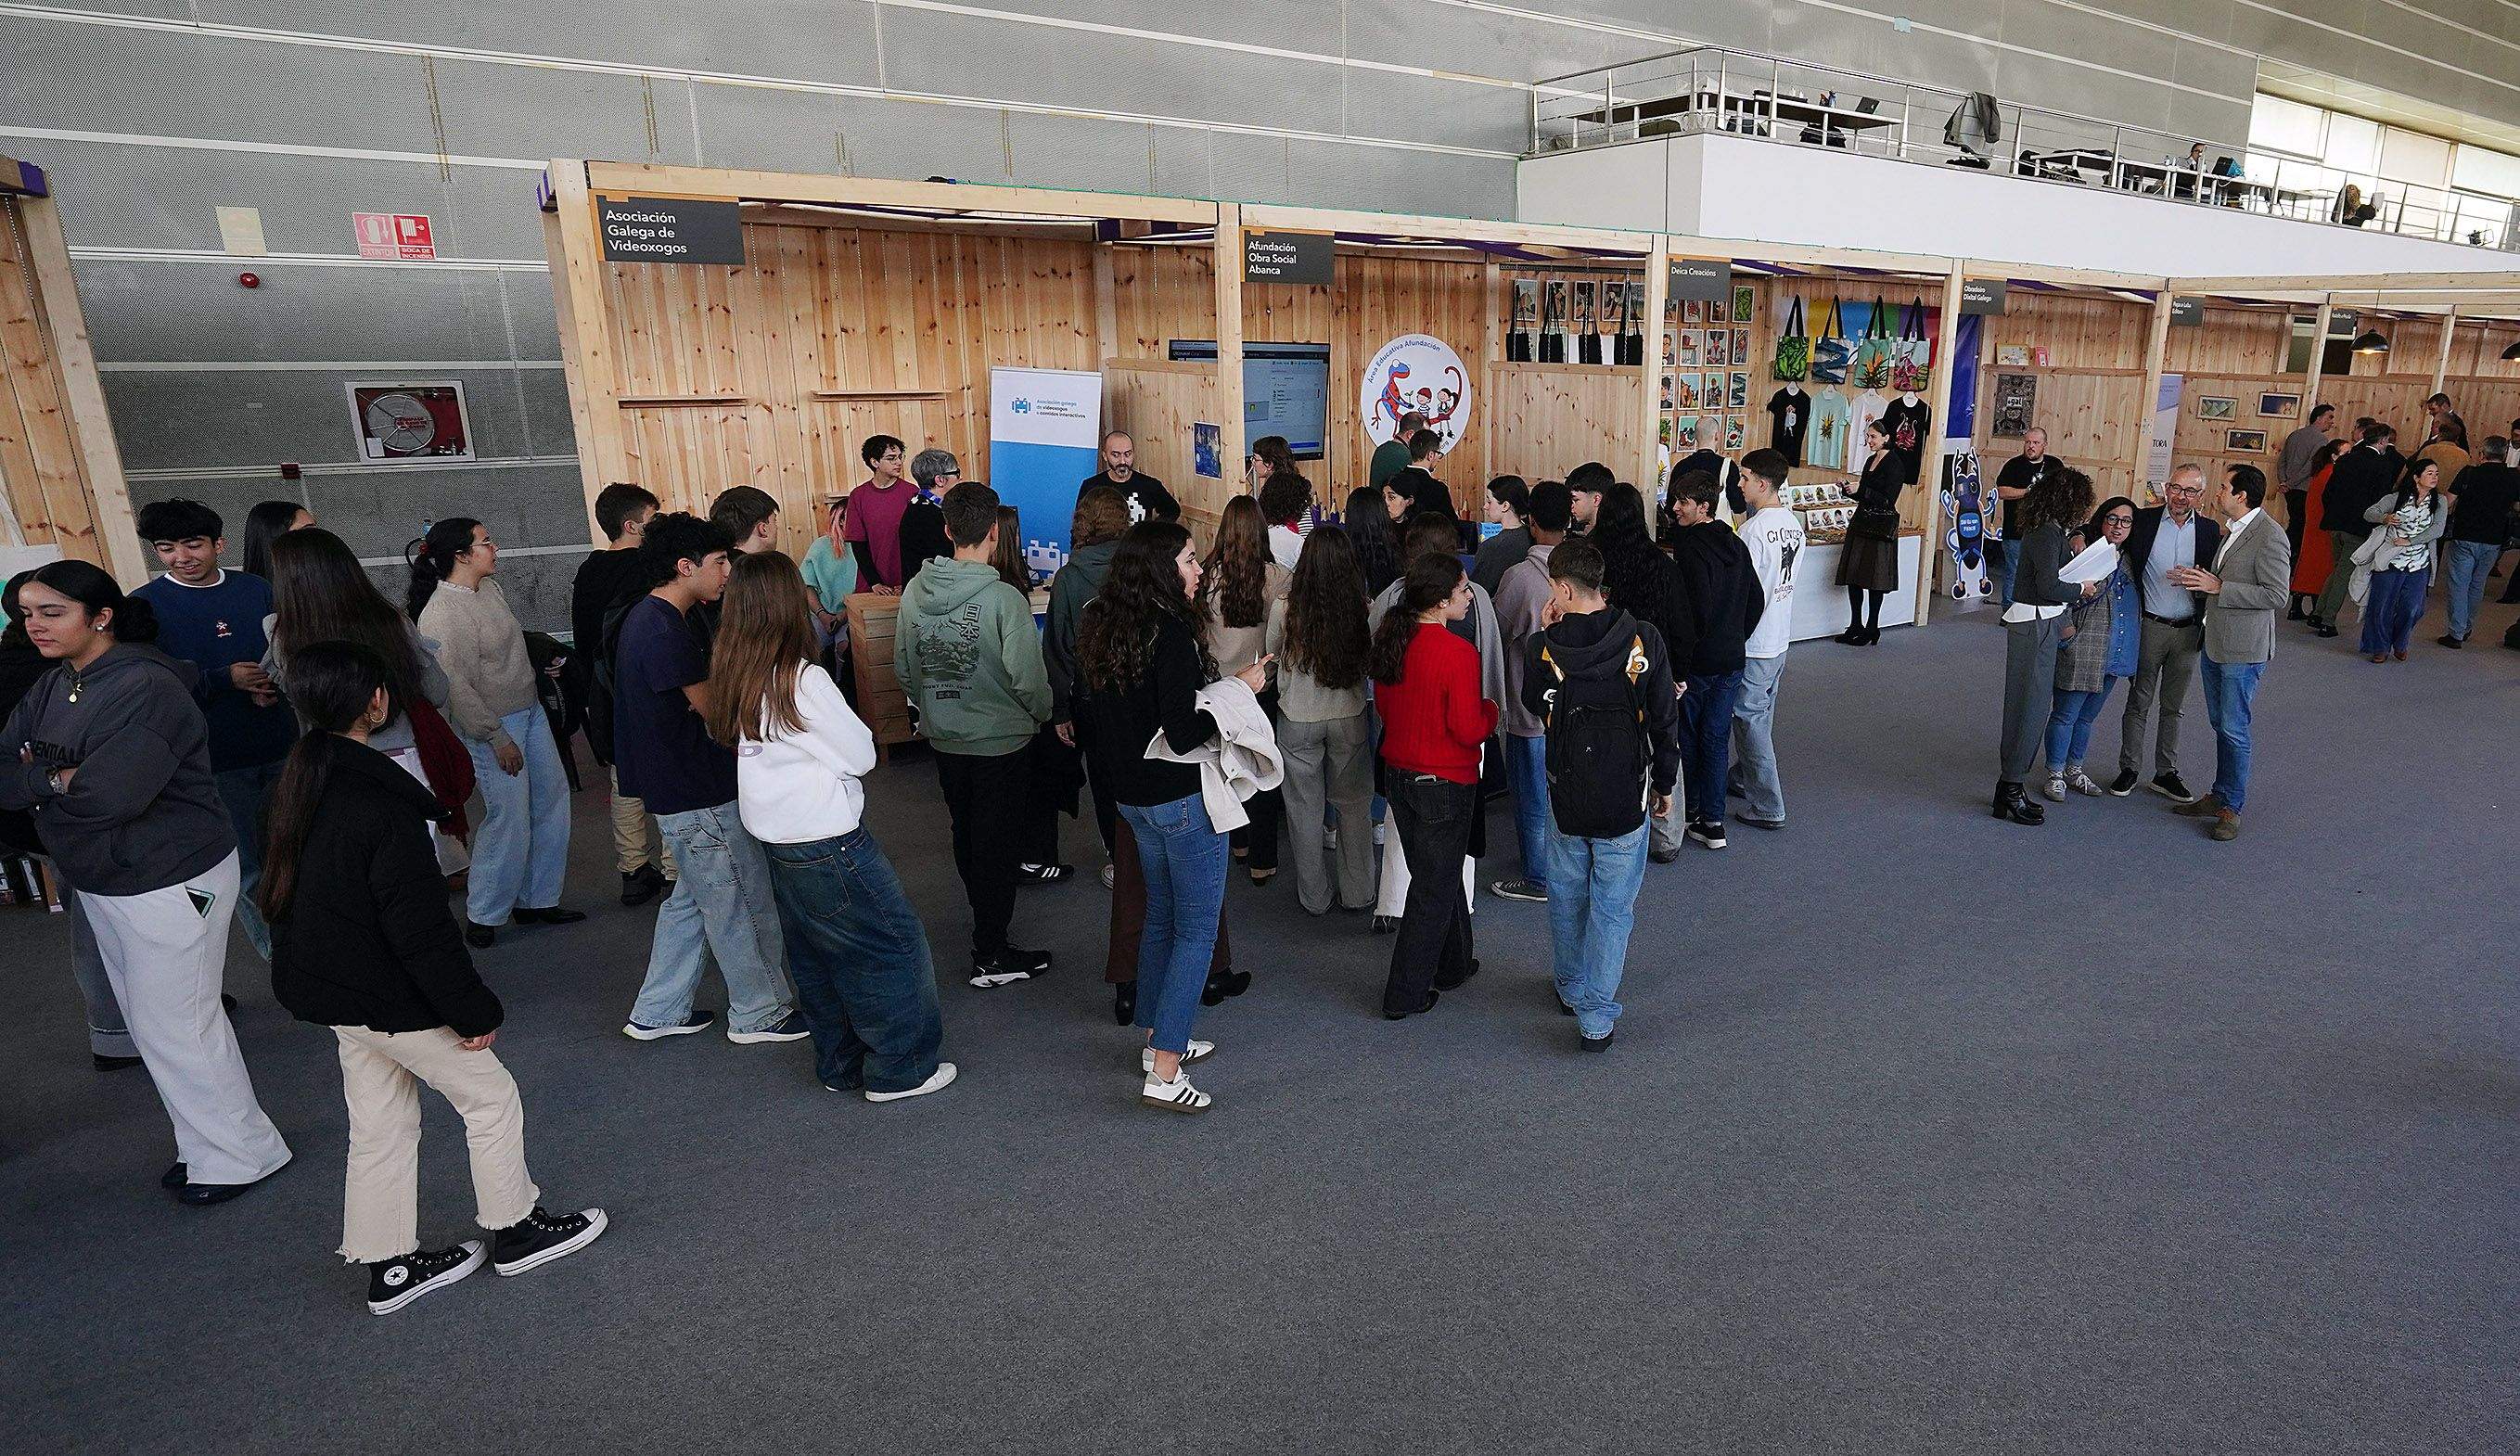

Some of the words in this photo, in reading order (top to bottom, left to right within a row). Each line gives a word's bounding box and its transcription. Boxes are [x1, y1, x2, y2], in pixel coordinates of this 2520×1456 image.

[606, 210, 676, 224] Asociación
[608, 224, 656, 239] Galega
[658, 226, 675, 238] de
[608, 240, 687, 256] Videoxogos
[1248, 241, 1297, 252] Afundación
[1248, 253, 1271, 262] Obra
[1272, 254, 1297, 263] Social
[1248, 264, 1281, 275] Abanca
[1671, 266, 1688, 275] Deica
[1688, 267, 1717, 277] Creacións
[1367, 367, 1378, 383] Área
[1375, 343, 1404, 367] Educativa
[1404, 339, 1441, 352] Afundación
[960, 602, 982, 641] 日本
